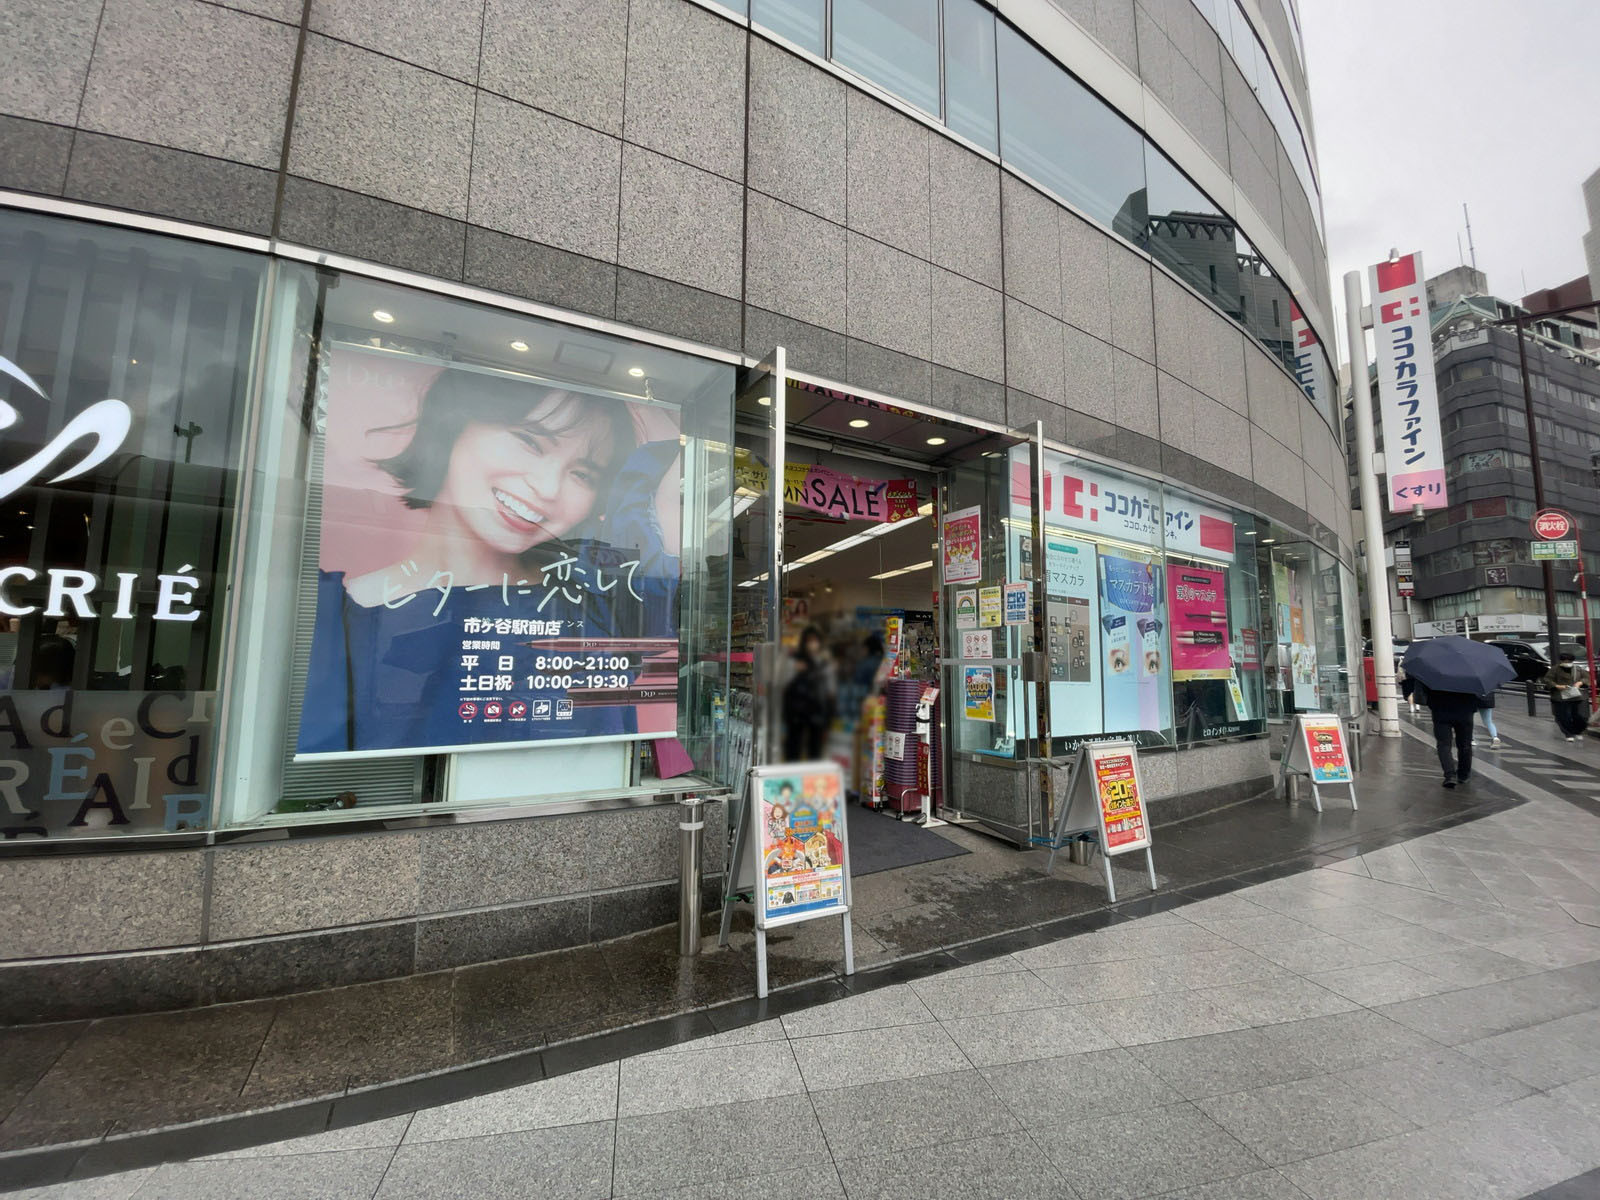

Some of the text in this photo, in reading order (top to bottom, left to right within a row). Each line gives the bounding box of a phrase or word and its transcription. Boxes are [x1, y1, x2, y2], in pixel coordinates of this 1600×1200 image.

[1391, 325, 1426, 466] ココカラファイン
[811, 478, 880, 517] SALE
[1395, 482, 1442, 499] くすり
[1104, 490, 1194, 531] ココカラァイン
[1538, 520, 1566, 531] 消火栓
[382, 551, 644, 616] ビターに恋して
[461, 640, 501, 651] 営業時間
[459, 675, 512, 691] 土日祝
